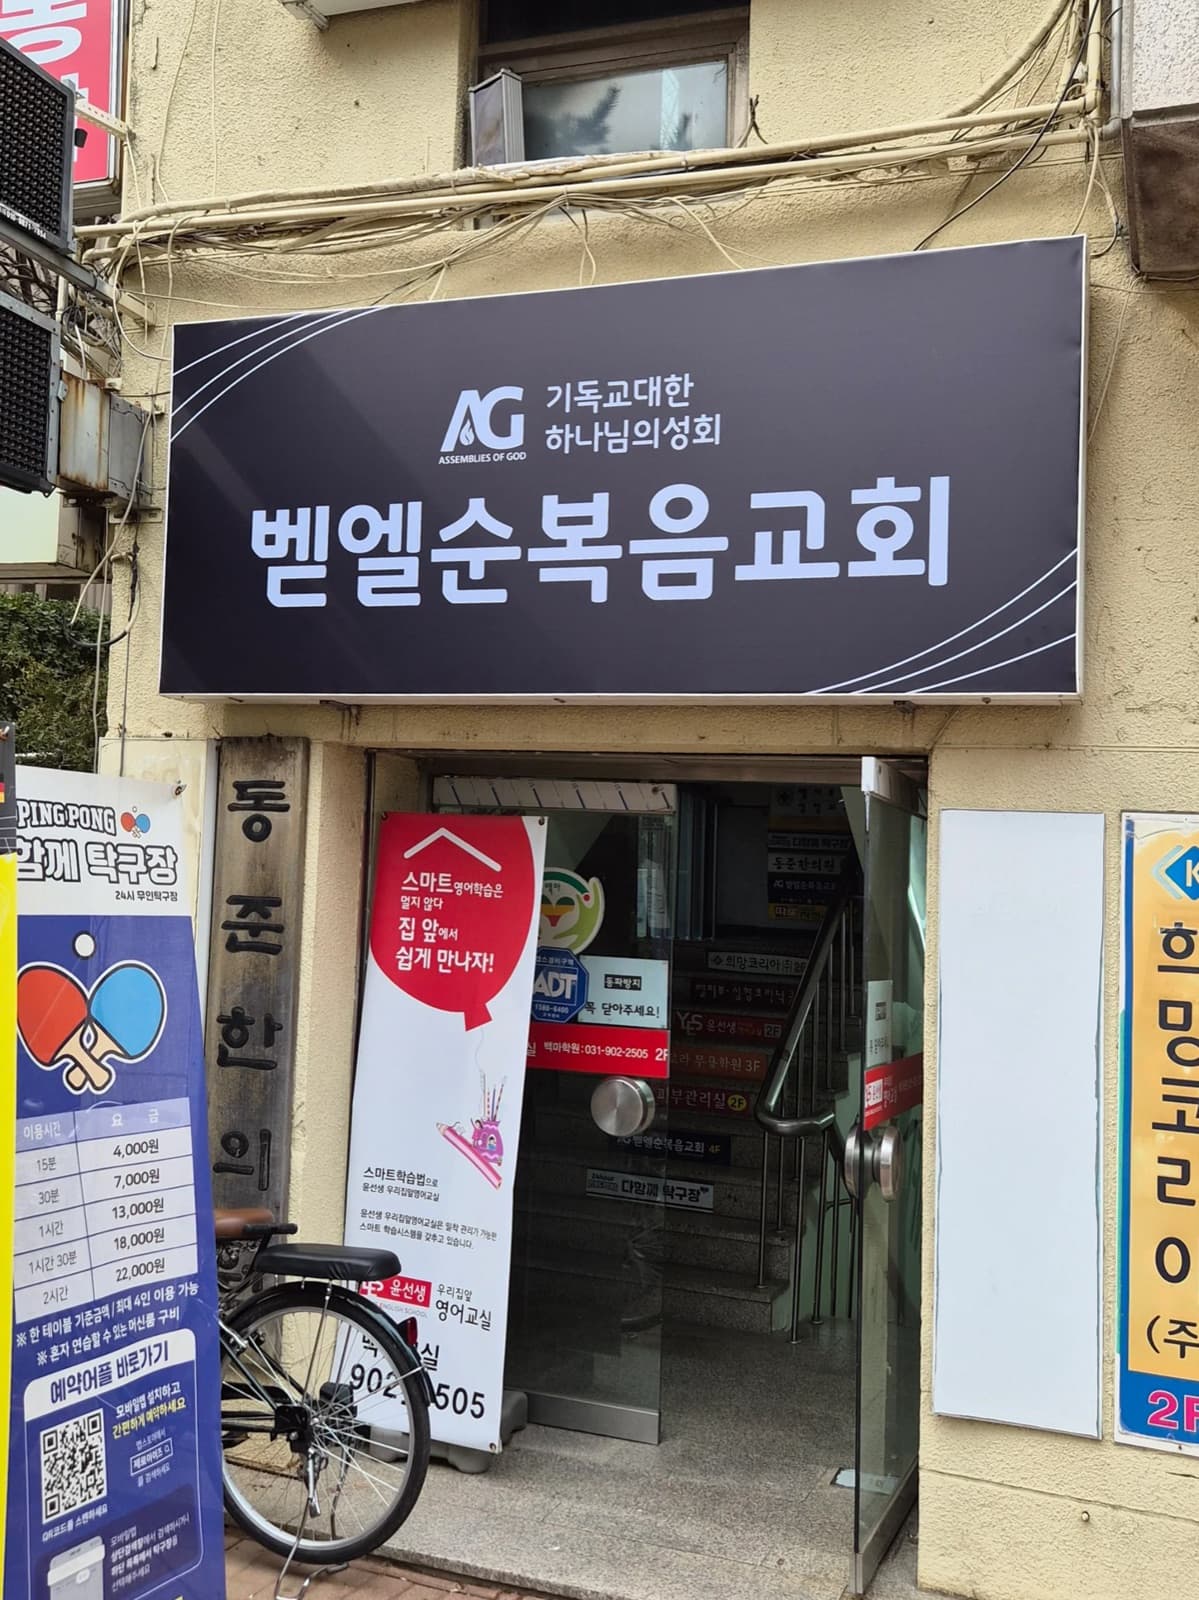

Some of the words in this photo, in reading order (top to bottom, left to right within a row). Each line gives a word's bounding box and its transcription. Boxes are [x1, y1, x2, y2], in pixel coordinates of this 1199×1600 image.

[546, 373, 694, 413] 기독교대한
[440, 386, 524, 452] AG
[545, 413, 721, 454] 하나님의성회
[438, 454, 491, 465] ASSEMBLIES
[493, 453, 504, 461] OF
[506, 451, 527, 461] GOD
[251, 476, 950, 607] 벧엘순복음교회
[66, 802, 117, 836] PONG
[85, 841, 178, 885] 탁구장
[115, 891, 135, 901] 24시
[137, 891, 178, 902] 무인탁구장
[400, 895, 420, 910] 멀지
[424, 897, 444, 911] 않다
[398, 917, 415, 941] 집
[396, 946, 431, 971] 쉽게
[437, 950, 494, 974] 만나자!
[534, 972, 577, 1000] ADT
[606, 976, 641, 990] 동파방지
[601, 1002, 660, 1019] 닫아주세요!
[745, 1060, 761, 1072] 3F
[23, 1121, 61, 1140] 이용시간
[113, 1138, 160, 1158] 4,000원
[36, 1157, 57, 1173] 15분
[114, 1168, 160, 1189] 7,000원
[362, 1183, 384, 1194] 윤선생
[38, 1188, 60, 1205] 30분
[662, 1184, 701, 1203] 탁구장
[112, 1197, 165, 1219] 13,000원
[360, 1209, 383, 1220] 윤선생
[39, 1221, 64, 1238] 1시간
[114, 1227, 165, 1250] 18,000원
[360, 1223, 381, 1233] 스마트
[29, 1256, 54, 1275] 1시간
[57, 1251, 77, 1268] 30분
[115, 1257, 166, 1282] 22,000원
[43, 1285, 68, 1304] 2시간
[390, 1280, 426, 1303] 윤선생
[436, 1283, 472, 1302] 우리집앞
[29, 1327, 40, 1344] 한
[43, 1316, 73, 1338] 테이블
[135, 1292, 151, 1309] 4인
[154, 1286, 175, 1301] 이용
[178, 1281, 200, 1297] 가능
[435, 1300, 492, 1331] 영어교실
[50, 1343, 70, 1362] 혼자
[72, 1335, 101, 1355] 연습할
[102, 1330, 110, 1342] 수
[113, 1325, 128, 1341] 있는
[158, 1307, 180, 1326] 구비
[50, 1362, 113, 1404] 예약어플
[116, 1340, 169, 1380] 바로가기
[147, 1382, 181, 1405] 설치하고
[112, 1415, 145, 1440] 간편하게
[146, 1398, 187, 1424] 예약하세요
